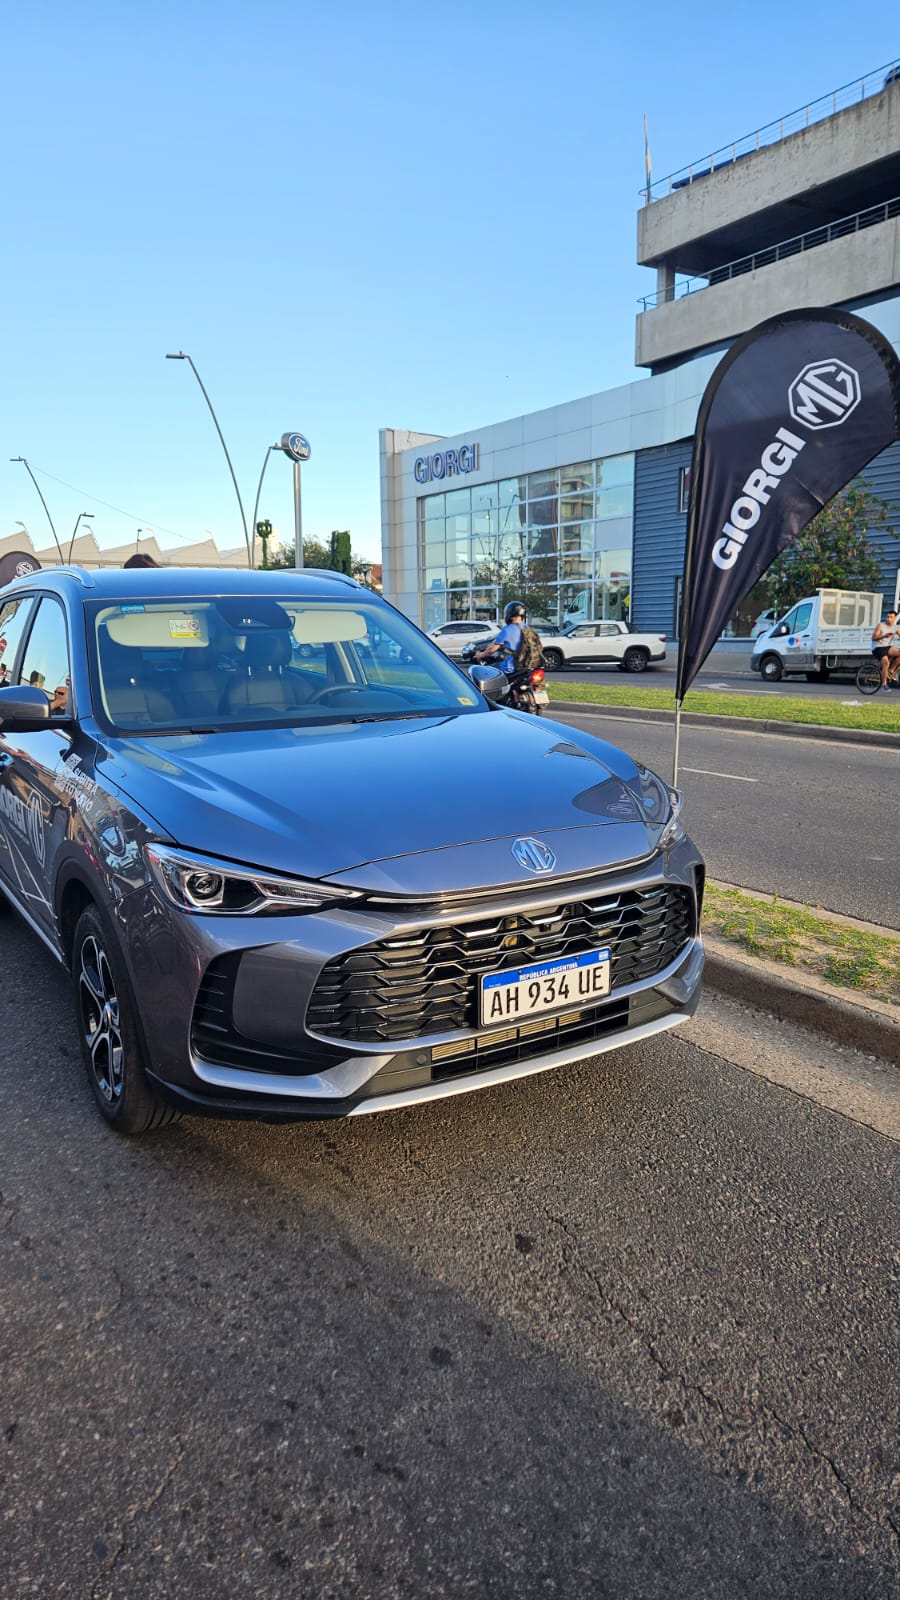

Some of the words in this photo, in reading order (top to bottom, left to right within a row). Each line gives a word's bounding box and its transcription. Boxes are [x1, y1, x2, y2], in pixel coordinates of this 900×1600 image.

[796, 364, 855, 424] MG
[413, 442, 480, 485] GIORGI
[711, 426, 807, 571] GIORGI
[514, 840, 553, 871] MG
[490, 986, 519, 1018] AH
[528, 974, 570, 1008] 934
[578, 966, 604, 995] UE
[549, 961, 578, 976] ARGENTINA
